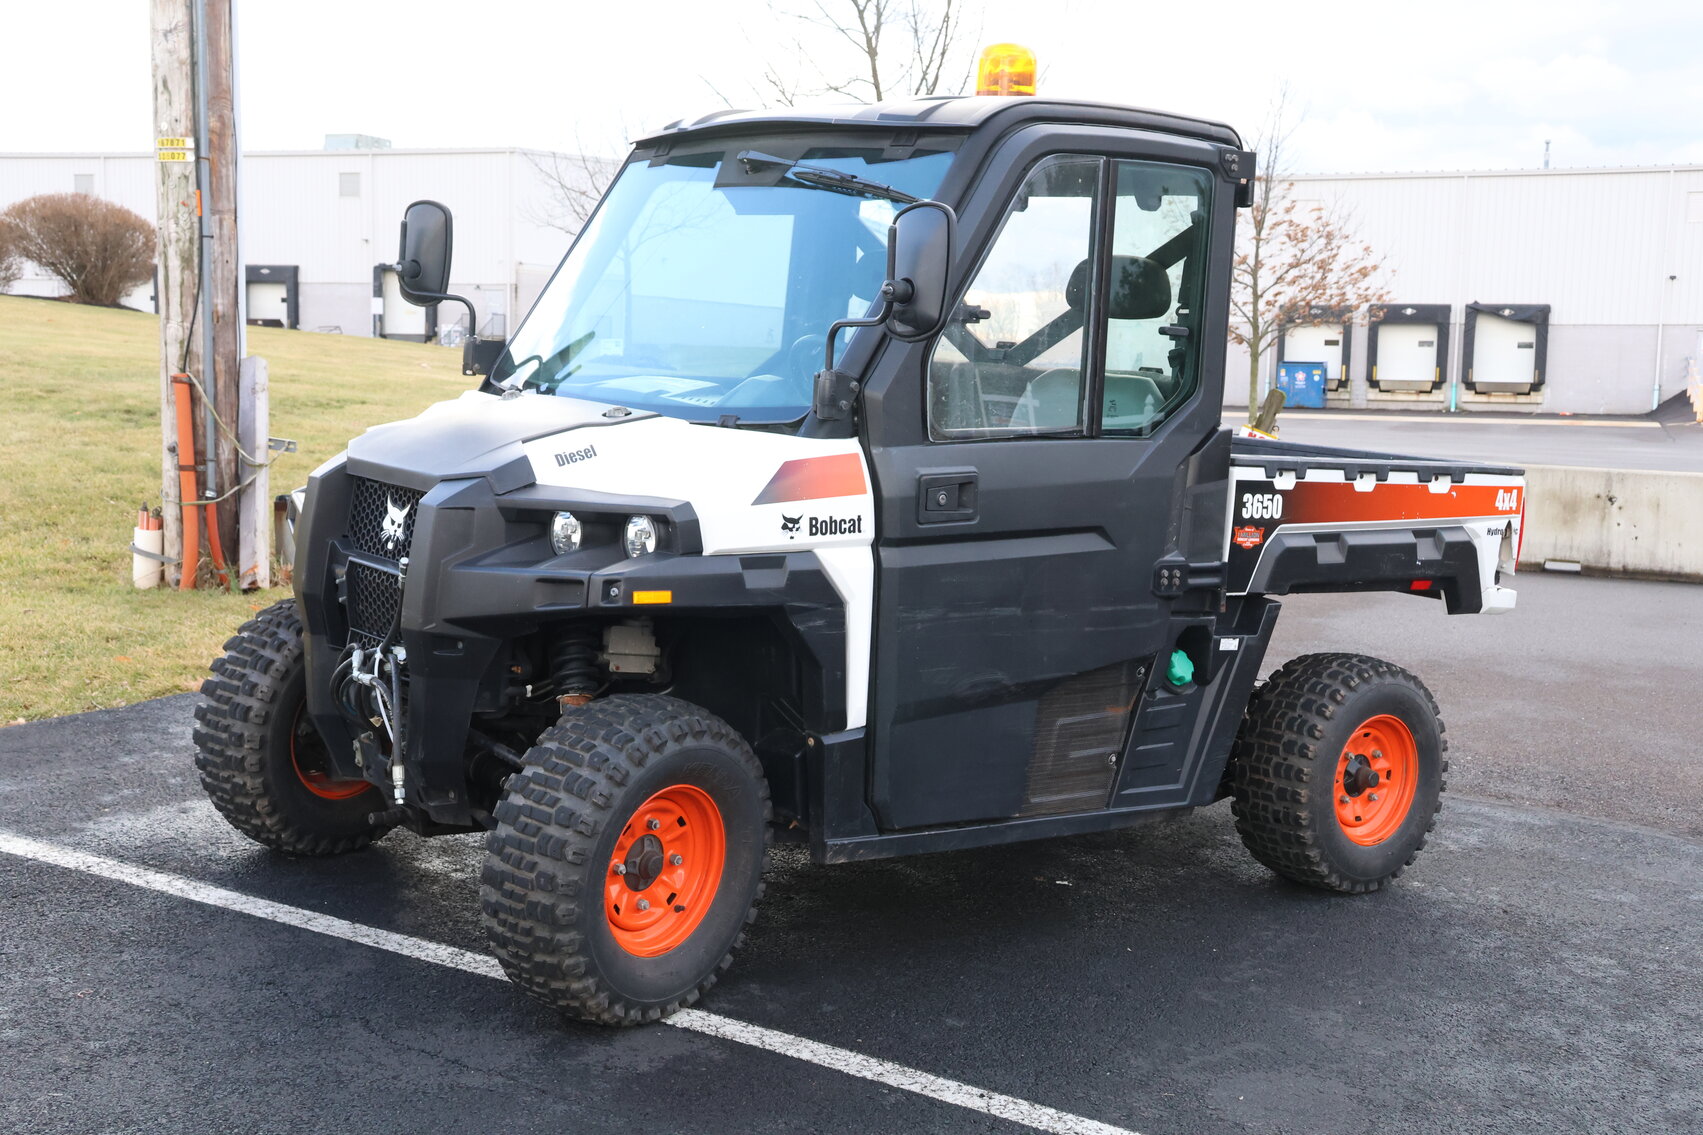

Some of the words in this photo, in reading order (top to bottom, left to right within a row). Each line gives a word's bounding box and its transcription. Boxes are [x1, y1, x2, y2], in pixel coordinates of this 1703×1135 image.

[554, 444, 598, 467] Diesel
[1241, 493, 1283, 519] 3650
[1494, 488, 1518, 511] 4x4
[808, 515, 862, 536] Bobcat
